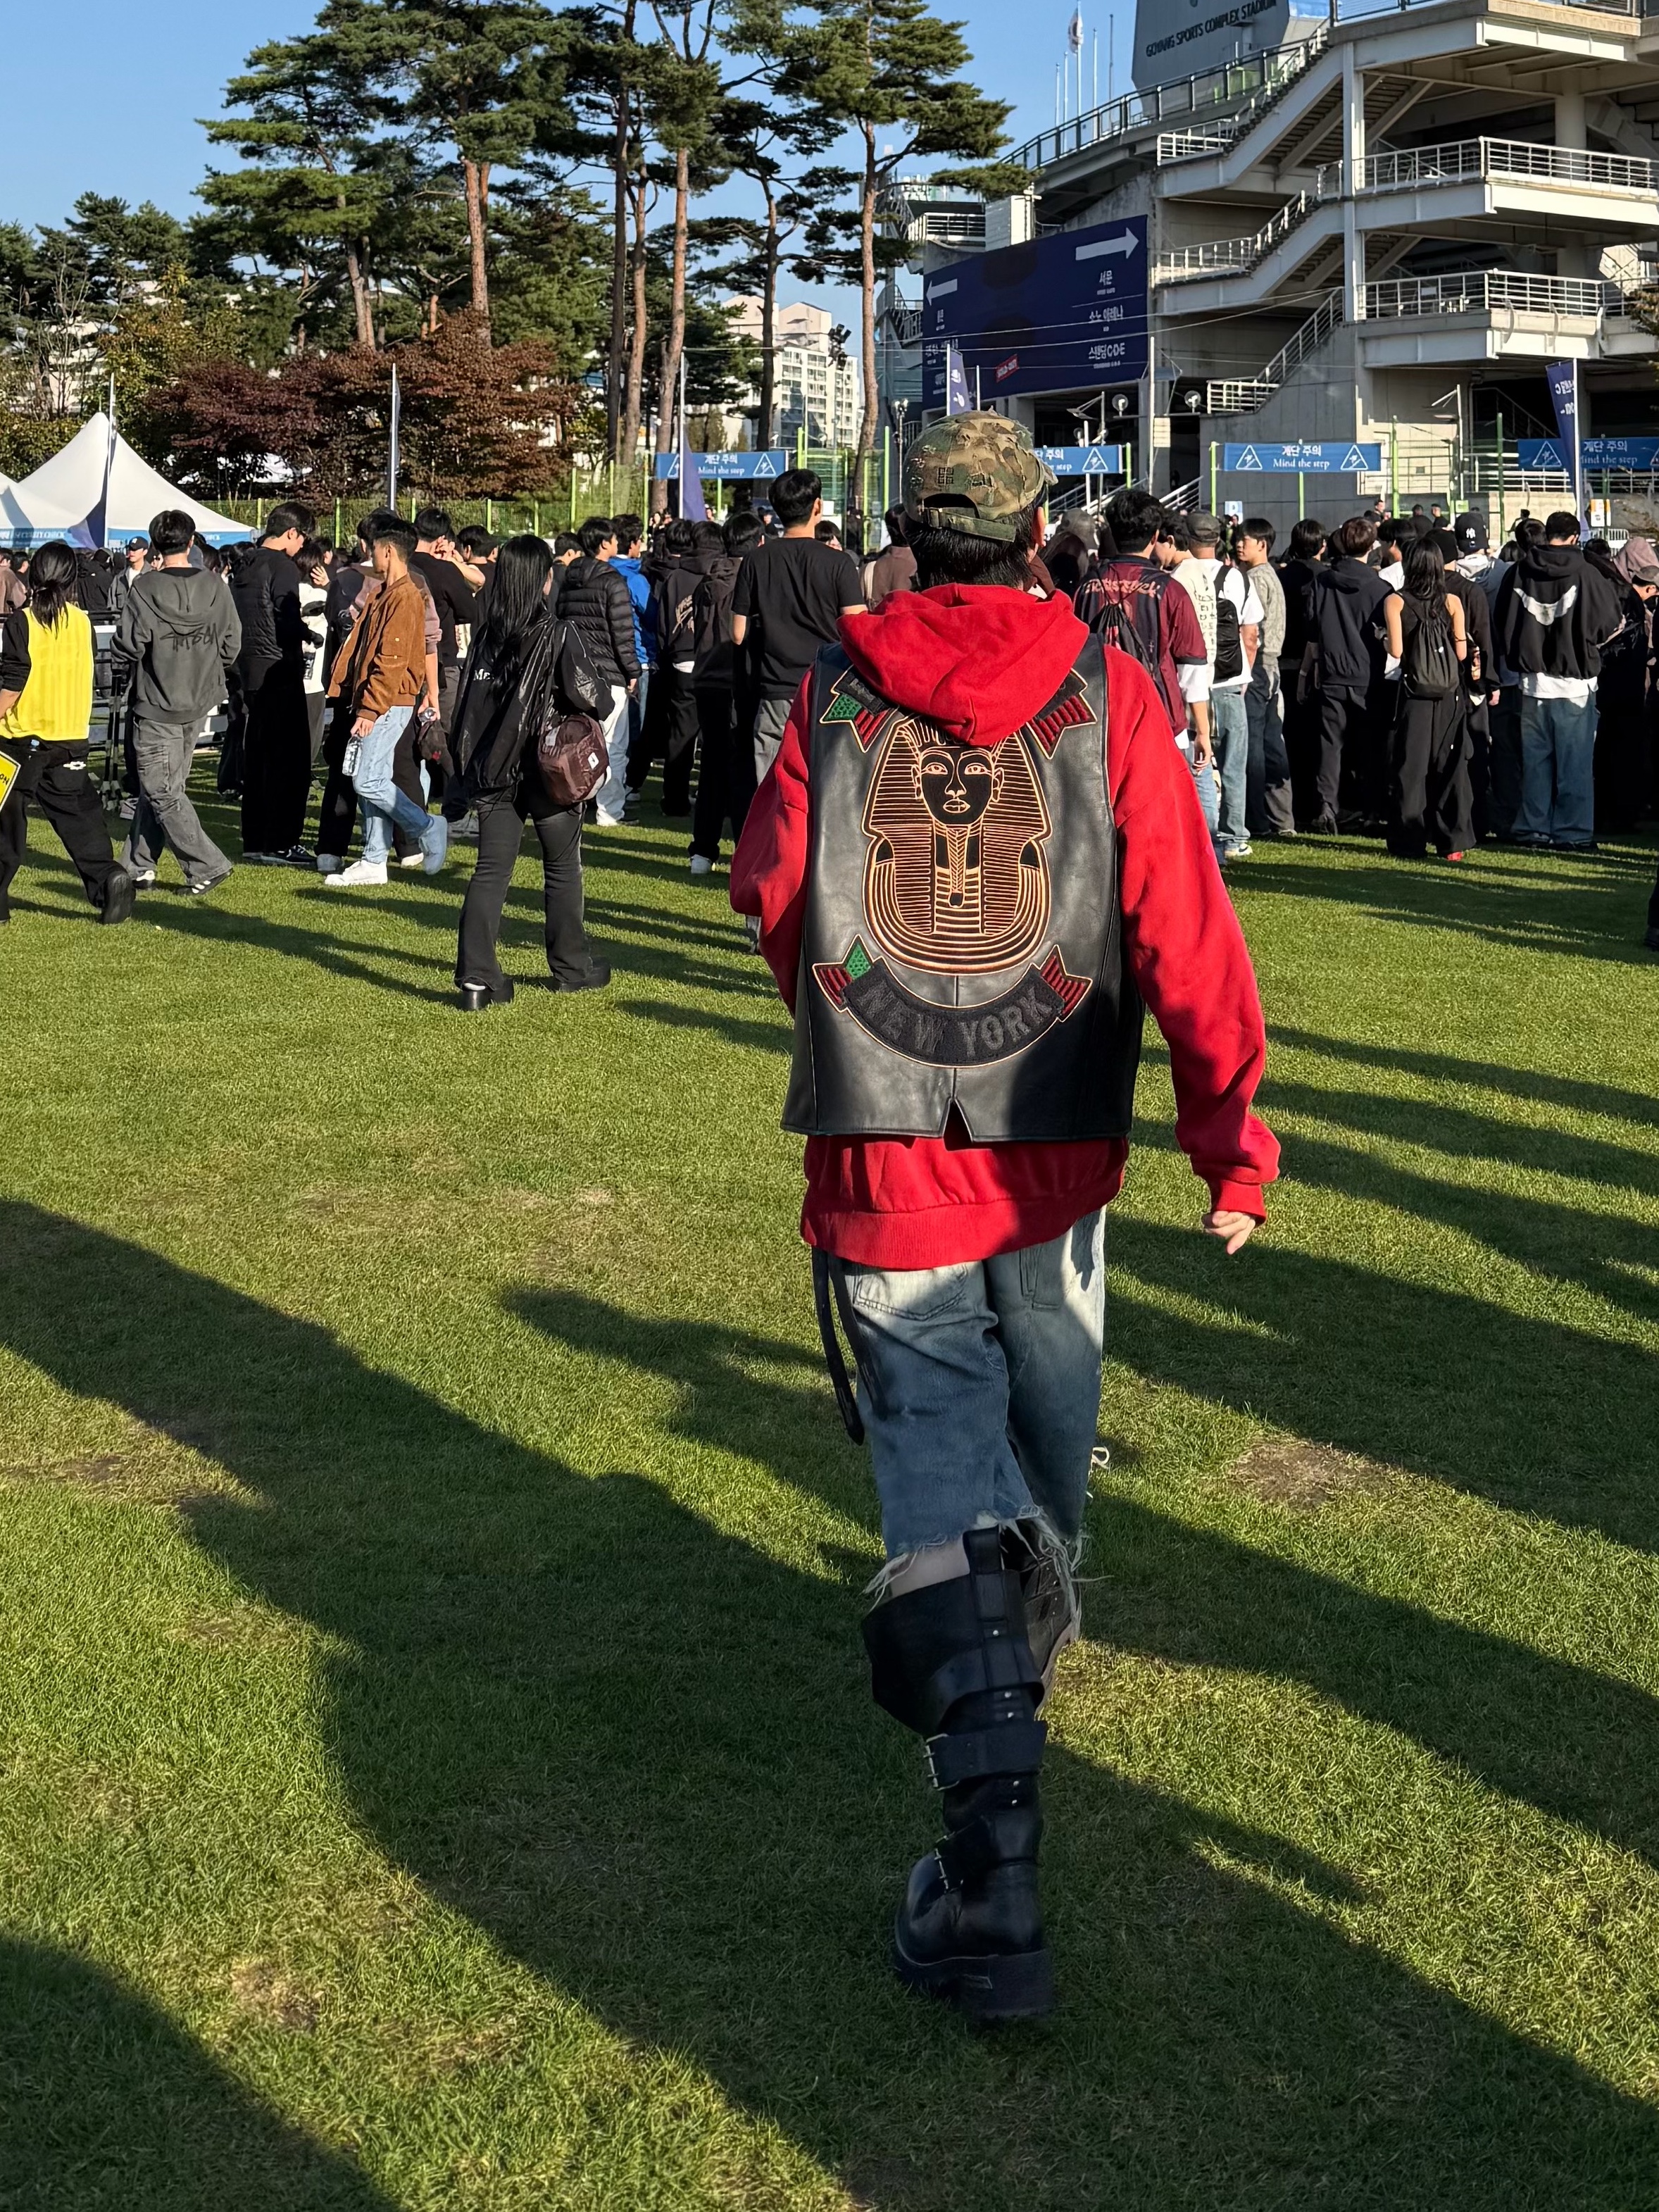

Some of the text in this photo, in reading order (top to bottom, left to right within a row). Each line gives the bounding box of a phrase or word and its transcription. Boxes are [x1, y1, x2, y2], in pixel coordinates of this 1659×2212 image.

[1176, 23, 1203, 45] SPORTS
[1205, 8, 1239, 33] COMPLEX
[1282, 445, 1321, 456] 계단 주의
[1584, 441, 1627, 452] 계단 주의
[704, 454, 737, 464] 계단 주의
[1046, 449, 1064, 460] 주의
[1602, 454, 1616, 463] the
[1619, 456, 1637, 466] step
[1273, 458, 1329, 470] Mind the step
[730, 467, 744, 476] step
[857, 981, 1053, 1056] NEW YORK
